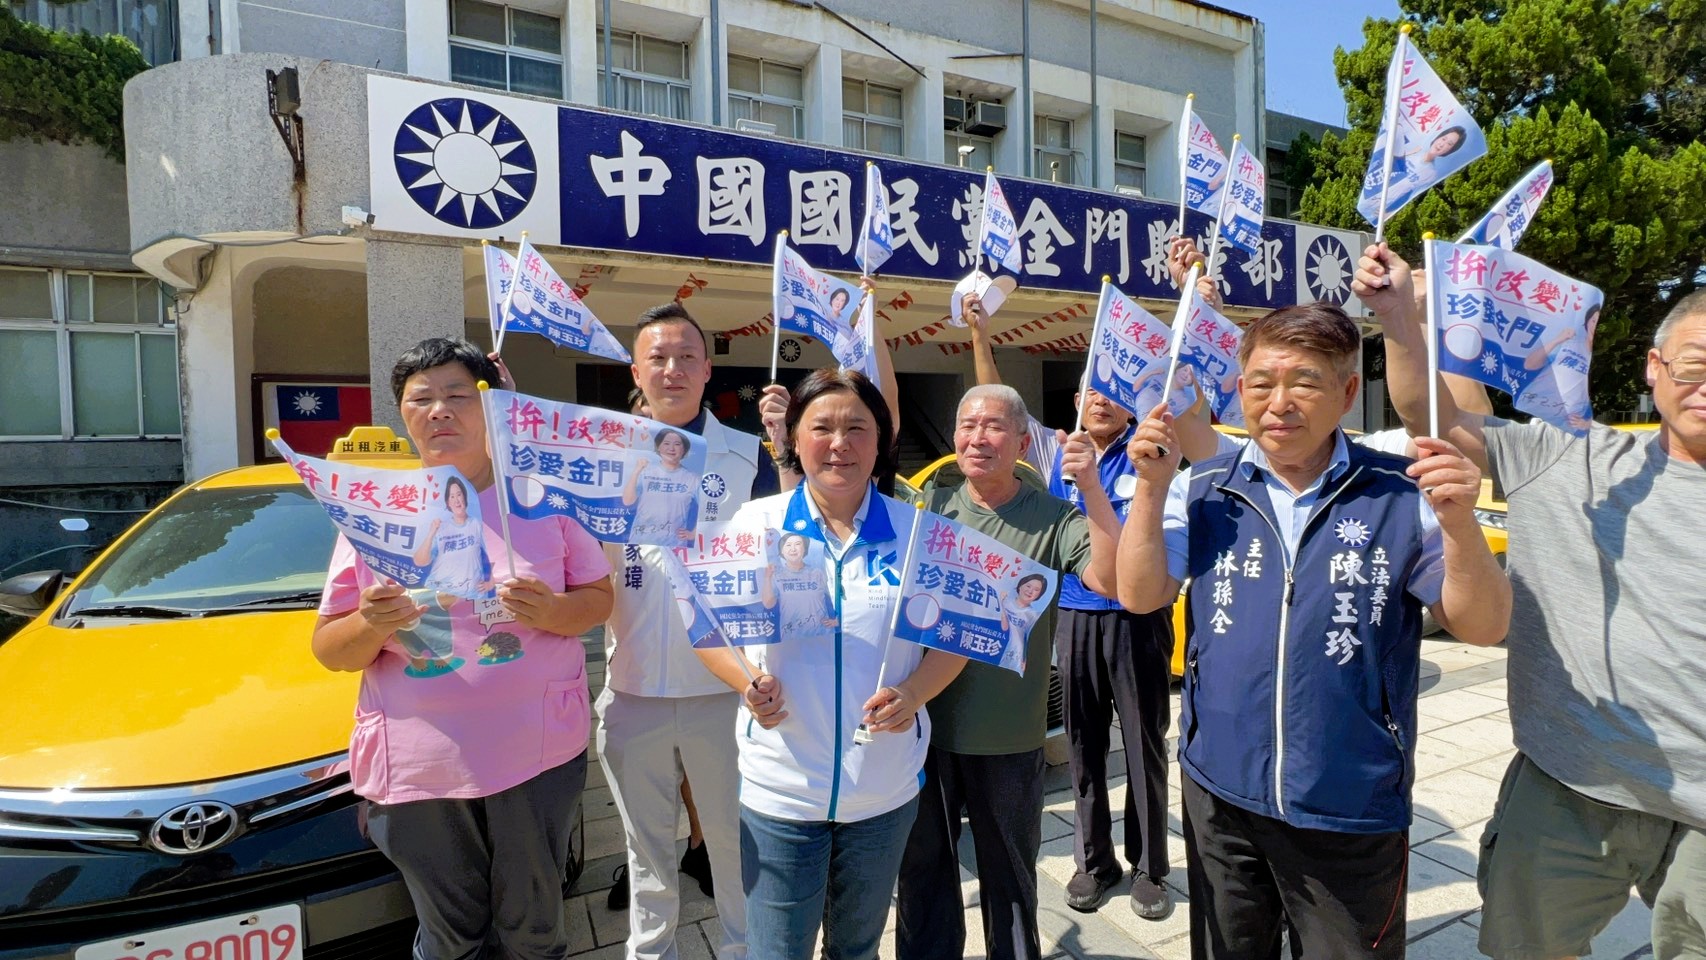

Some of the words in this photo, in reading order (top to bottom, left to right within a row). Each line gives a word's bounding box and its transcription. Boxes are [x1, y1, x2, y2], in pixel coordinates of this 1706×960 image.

[590, 130, 1284, 301] 中國國民黨金門縣黨部
[520, 272, 582, 326] 珍愛金門
[342, 441, 401, 453] 出租汽車
[505, 397, 634, 449] 拚!改變!
[509, 443, 625, 488] 珍愛金門
[321, 501, 417, 550] 愛金門
[575, 505, 629, 536] 陳玉珍
[360, 551, 421, 585] 陳玉珍
[924, 519, 1010, 580] 拚!改變!
[1243, 538, 1263, 578] 主任
[915, 562, 1001, 612] 珍愛金門
[1209, 550, 1239, 634] 林孫全
[1325, 550, 1369, 666] 陳玉珍
[1369, 547, 1391, 627] 立法委員
[723, 620, 775, 639] 陳玉珍
[960, 629, 1003, 656] 陳玉珍
